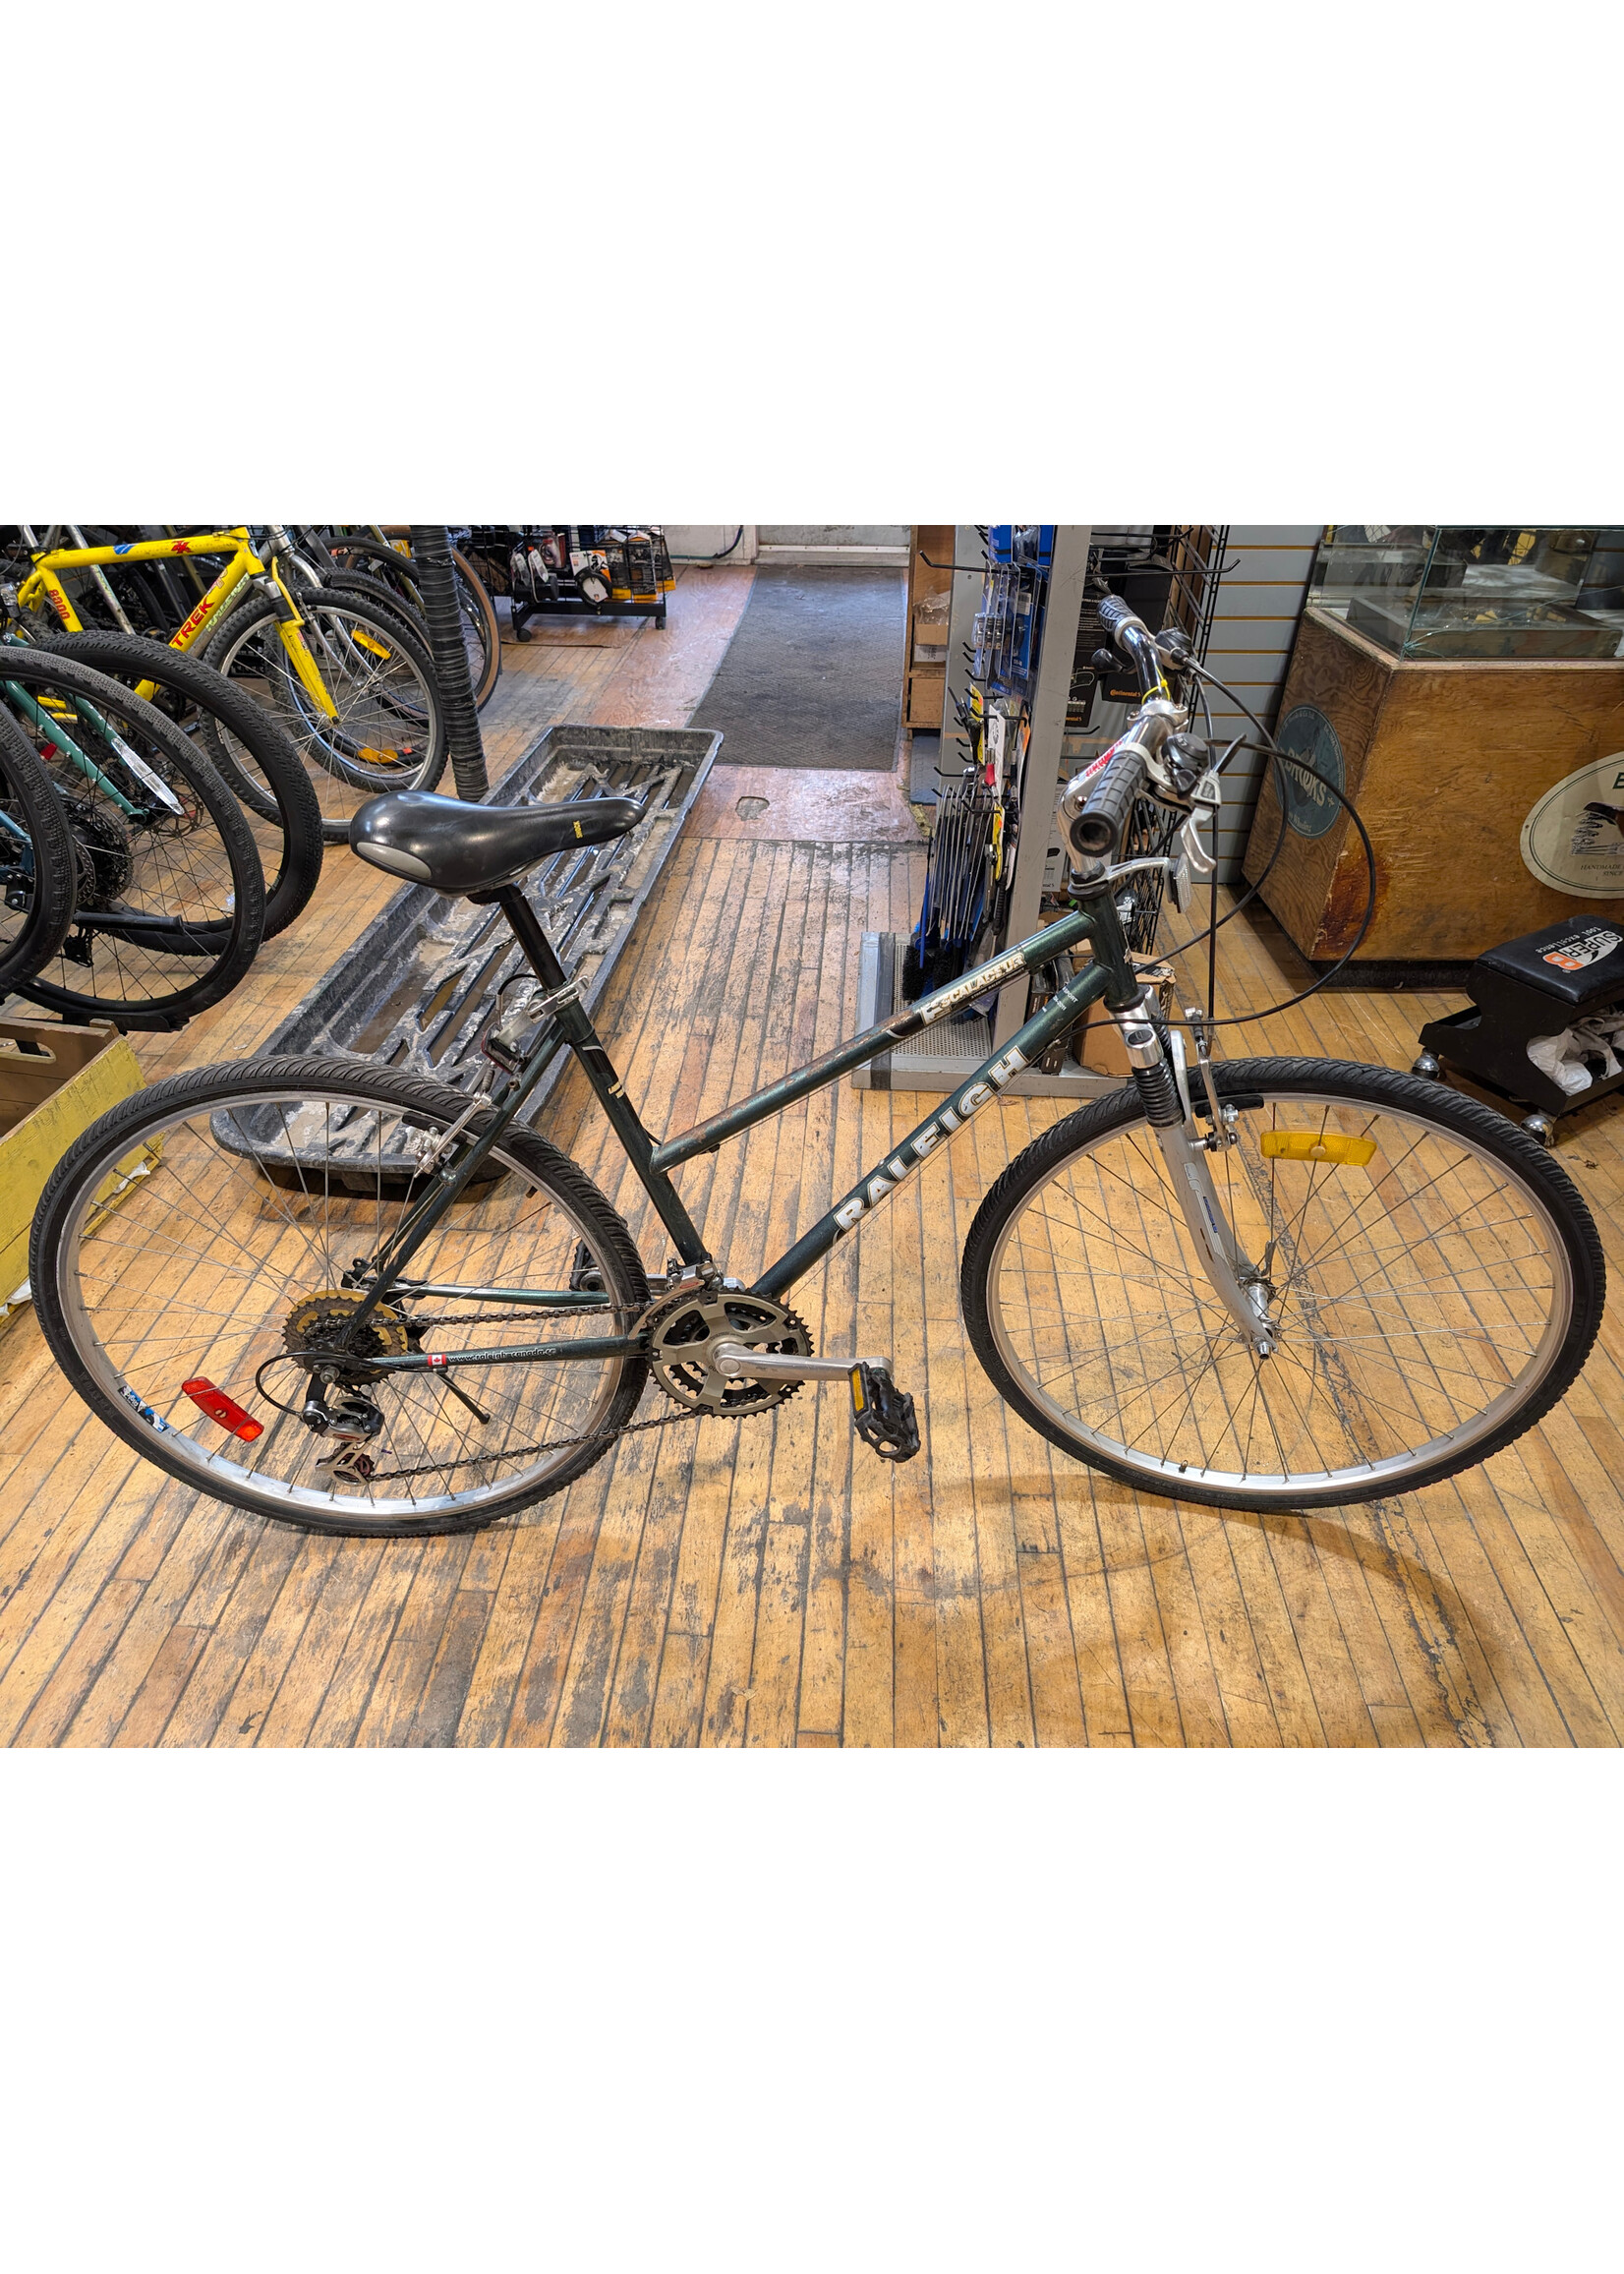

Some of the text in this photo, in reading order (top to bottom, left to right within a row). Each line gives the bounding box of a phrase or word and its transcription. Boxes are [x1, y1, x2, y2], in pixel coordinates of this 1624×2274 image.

[171, 597, 215, 647] TREK
[1284, 748, 1327, 806] BROOKS
[1536, 926, 1602, 954] tool excellence
[1562, 932, 1620, 958] SUPER
[834, 1045, 1029, 1232] RALEIGH
